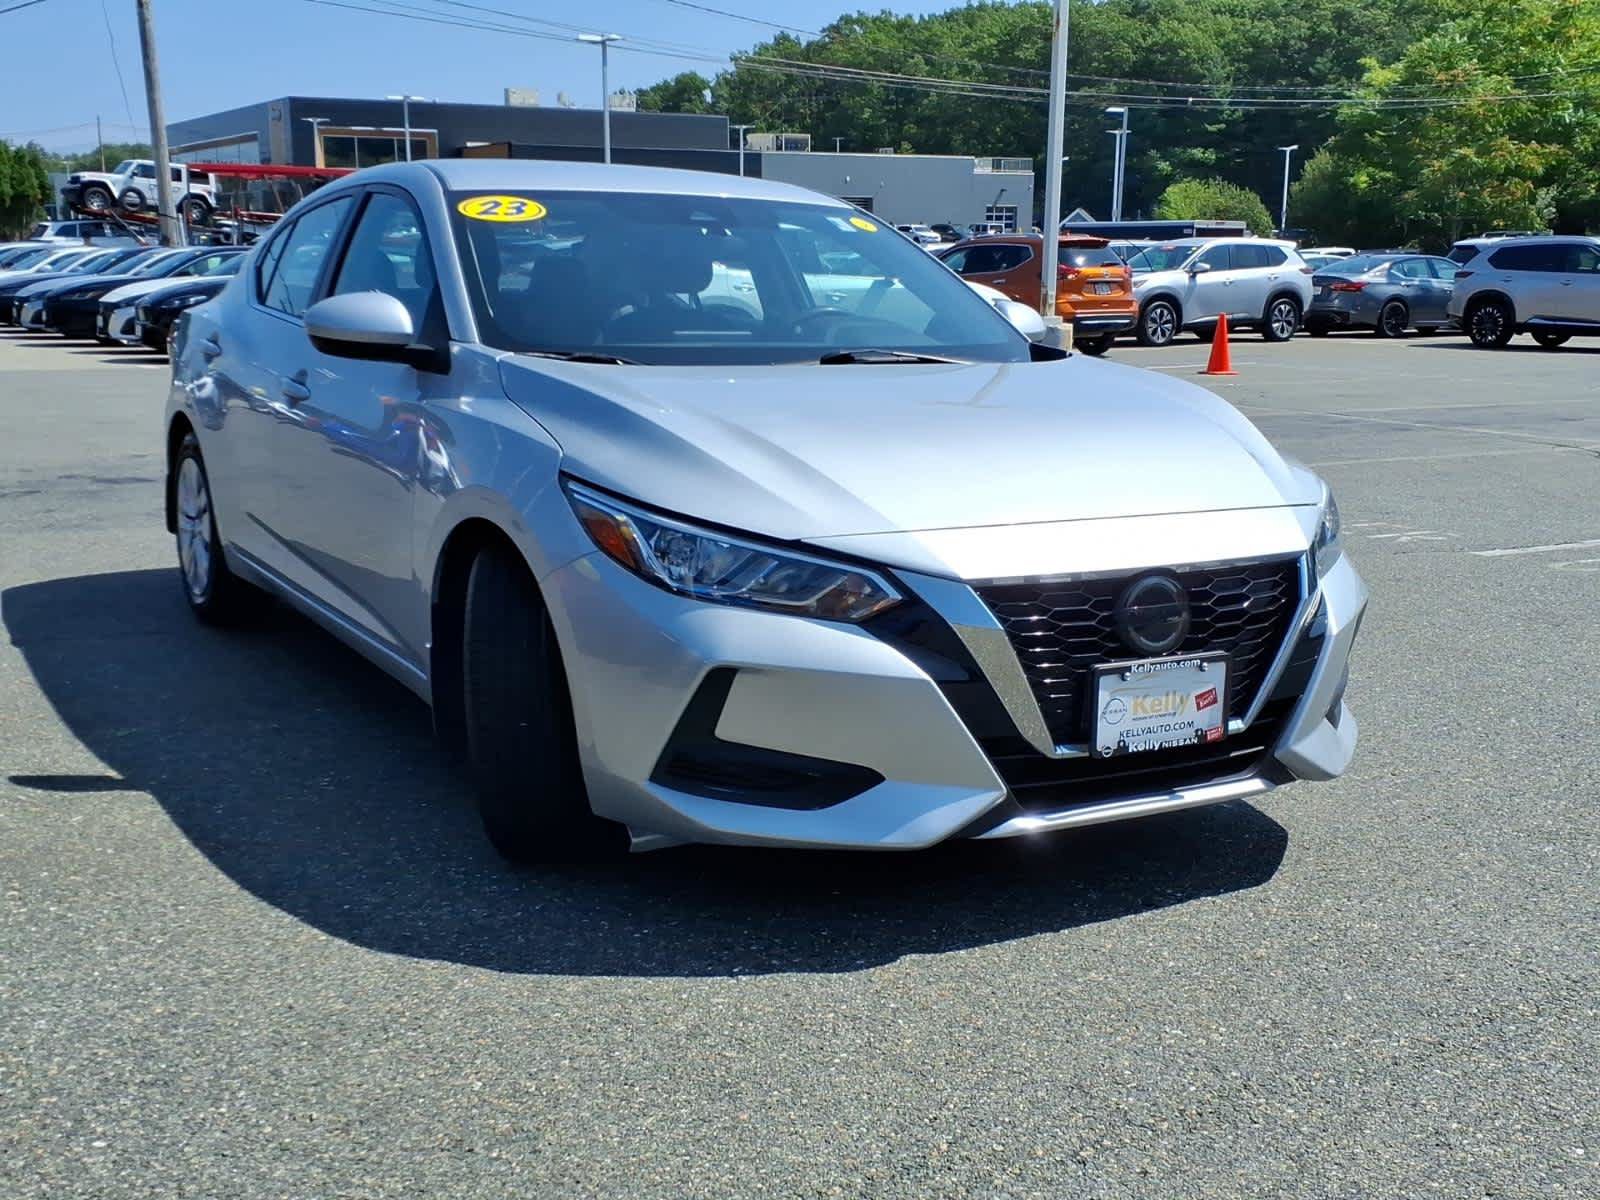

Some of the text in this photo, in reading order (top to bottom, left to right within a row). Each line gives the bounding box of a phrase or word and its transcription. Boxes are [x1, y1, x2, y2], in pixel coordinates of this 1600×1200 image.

[475, 199, 529, 216] 23
[1131, 659, 1201, 673] Kellyauto.com
[1131, 690, 1191, 716] Kelly
[1120, 720, 1195, 739] KELLYAUTO.COM
[1128, 737, 1199, 753] Kelly NISSAN
